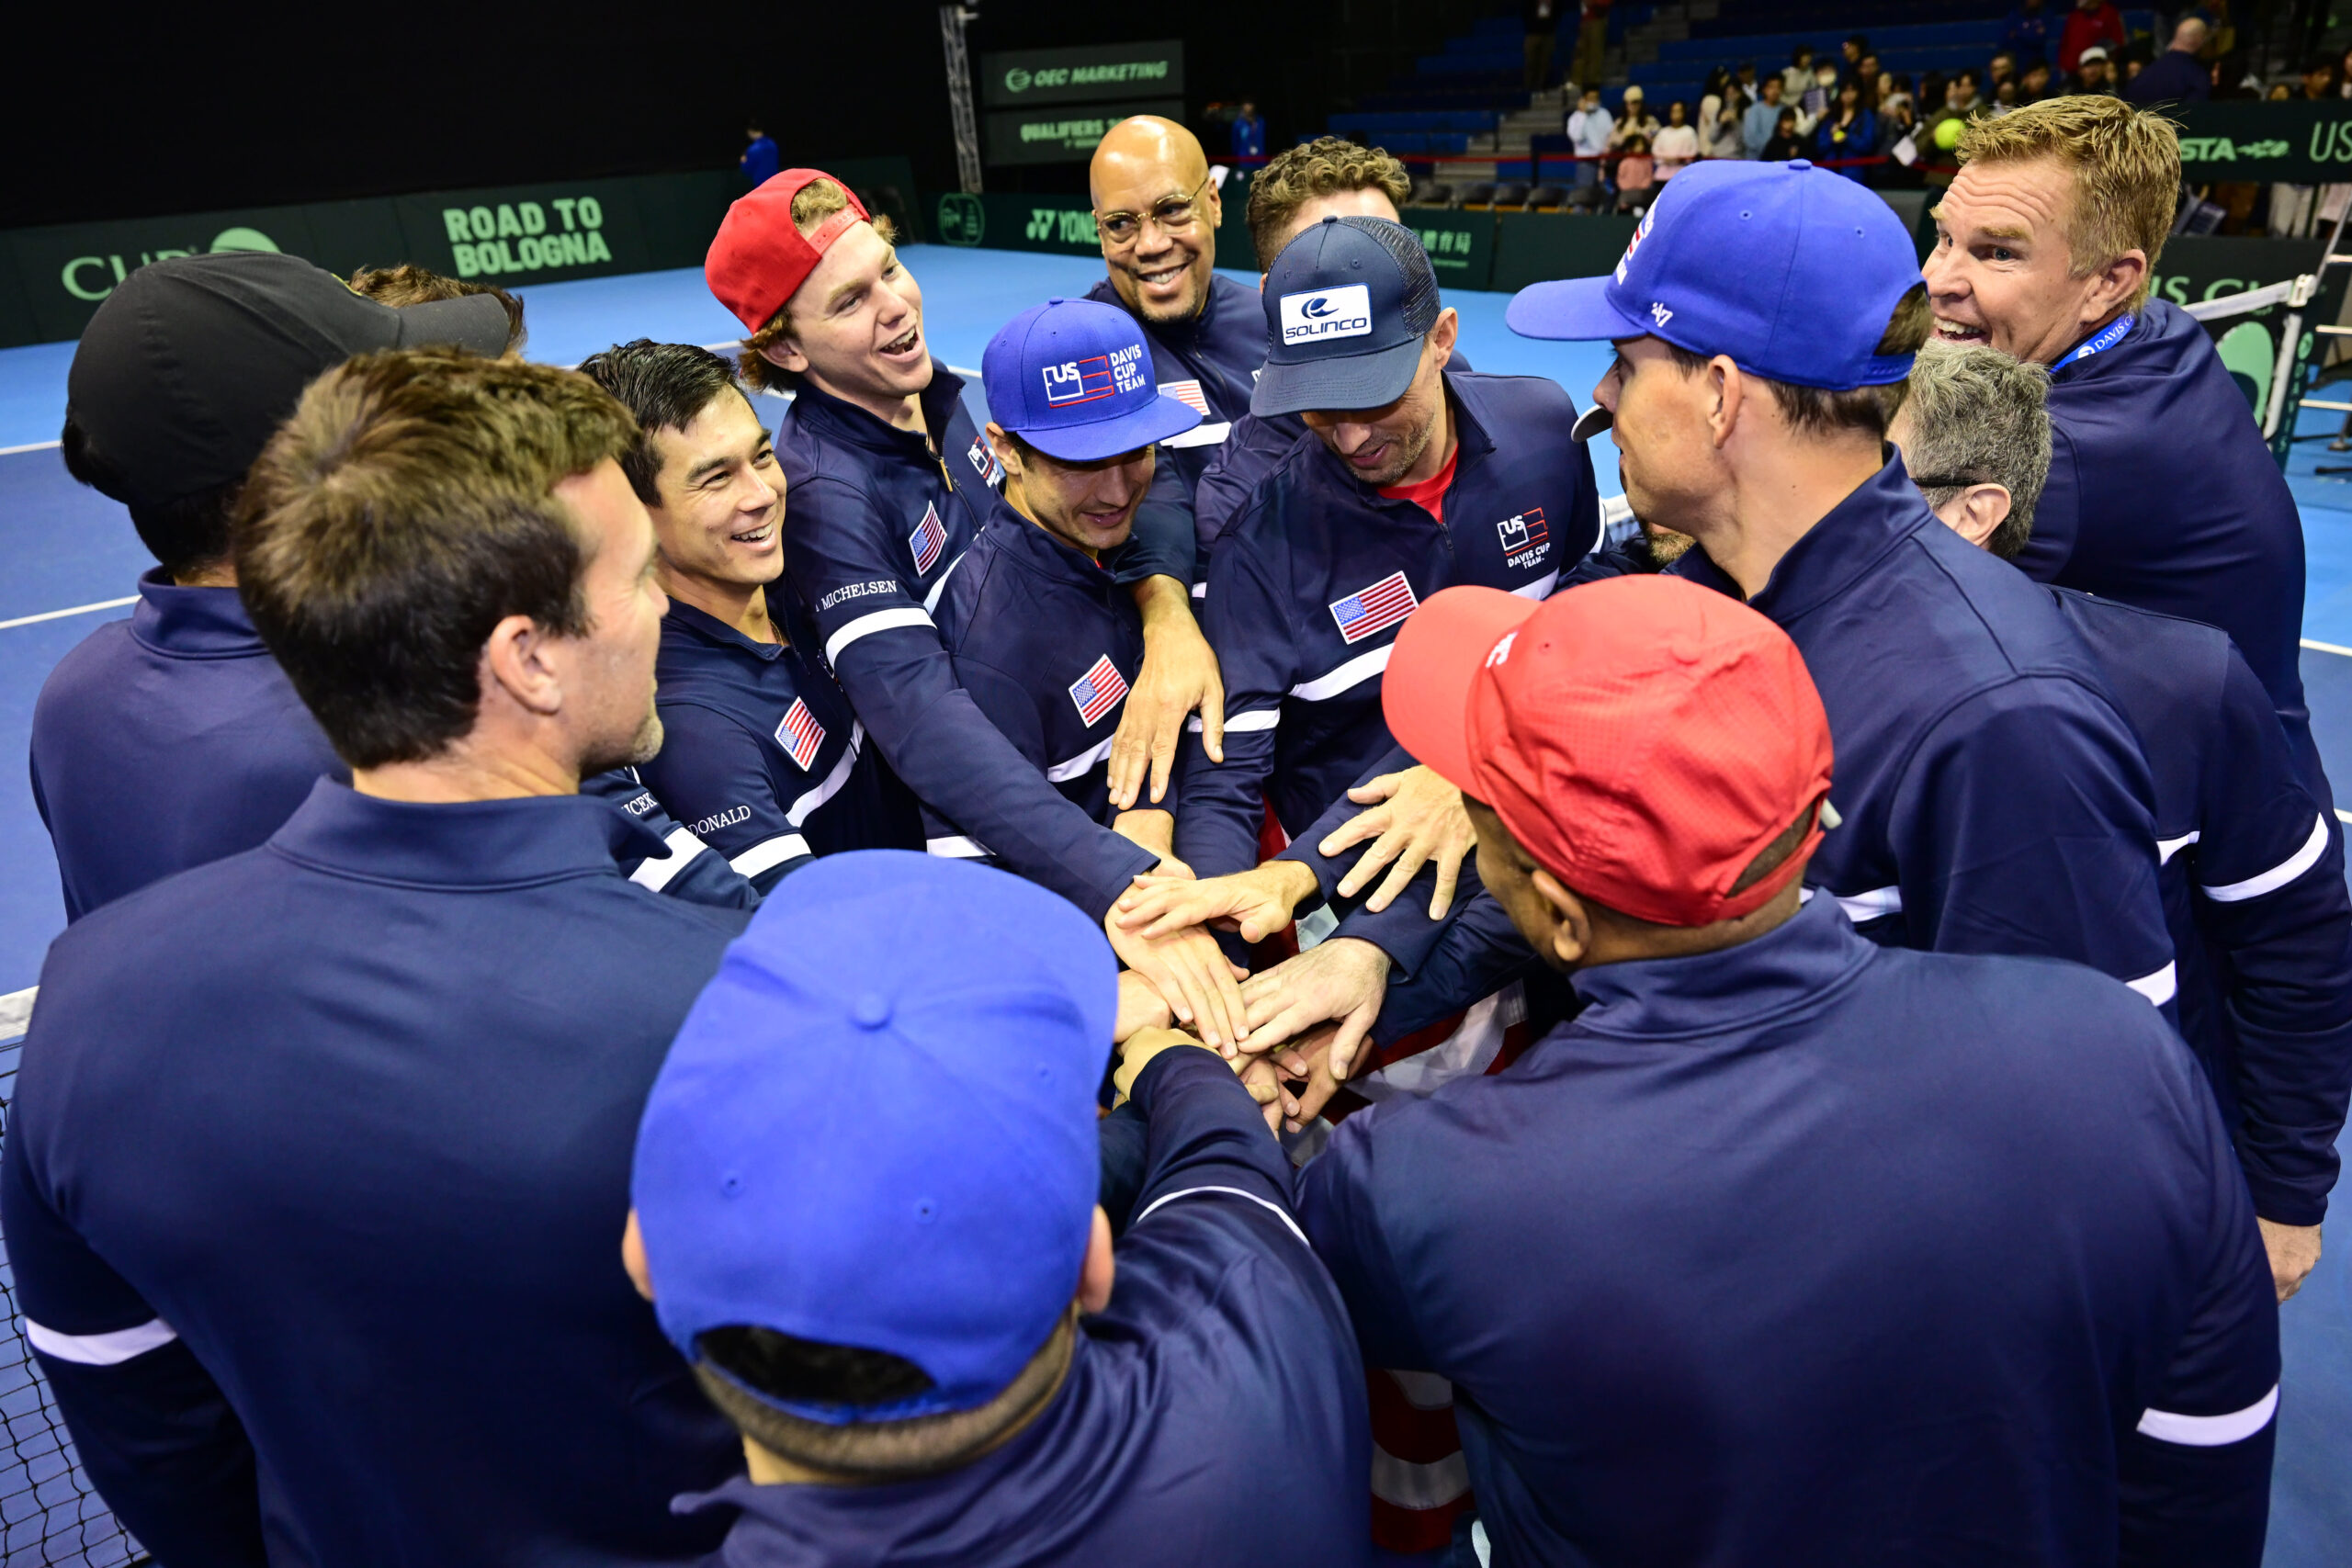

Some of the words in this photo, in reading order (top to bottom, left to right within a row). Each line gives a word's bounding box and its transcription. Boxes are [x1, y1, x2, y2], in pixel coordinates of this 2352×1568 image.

[1035, 69, 1069, 86] OEC
[1071, 61, 1168, 85] MARKETING
[1021, 119, 1103, 142] QUALIFIERS
[2179, 138, 2236, 162] STA
[443, 201, 547, 243] ROAD
[552, 197, 604, 231] TO
[1058, 209, 1102, 244] YONE
[1412, 228, 1471, 254] 體育局
[453, 230, 612, 277] BOLOGNA
[62, 249, 191, 300] CU
[1284, 317, 1367, 339] SOLINCO
[2095, 322, 2124, 350] DAVIS
[1110, 344, 1142, 367] DAVIS
[1052, 362, 1080, 383] US
[1114, 362, 1136, 381] CUP
[1116, 374, 1146, 394] TEAM
[1504, 514, 1523, 535] US
[1508, 549, 1534, 568] DAVIS
[1535, 542, 1551, 556] CUP
[1522, 555, 1542, 570] TEAM
[821, 581, 897, 610] MICHELSEN
[621, 792, 658, 816] ICEK
